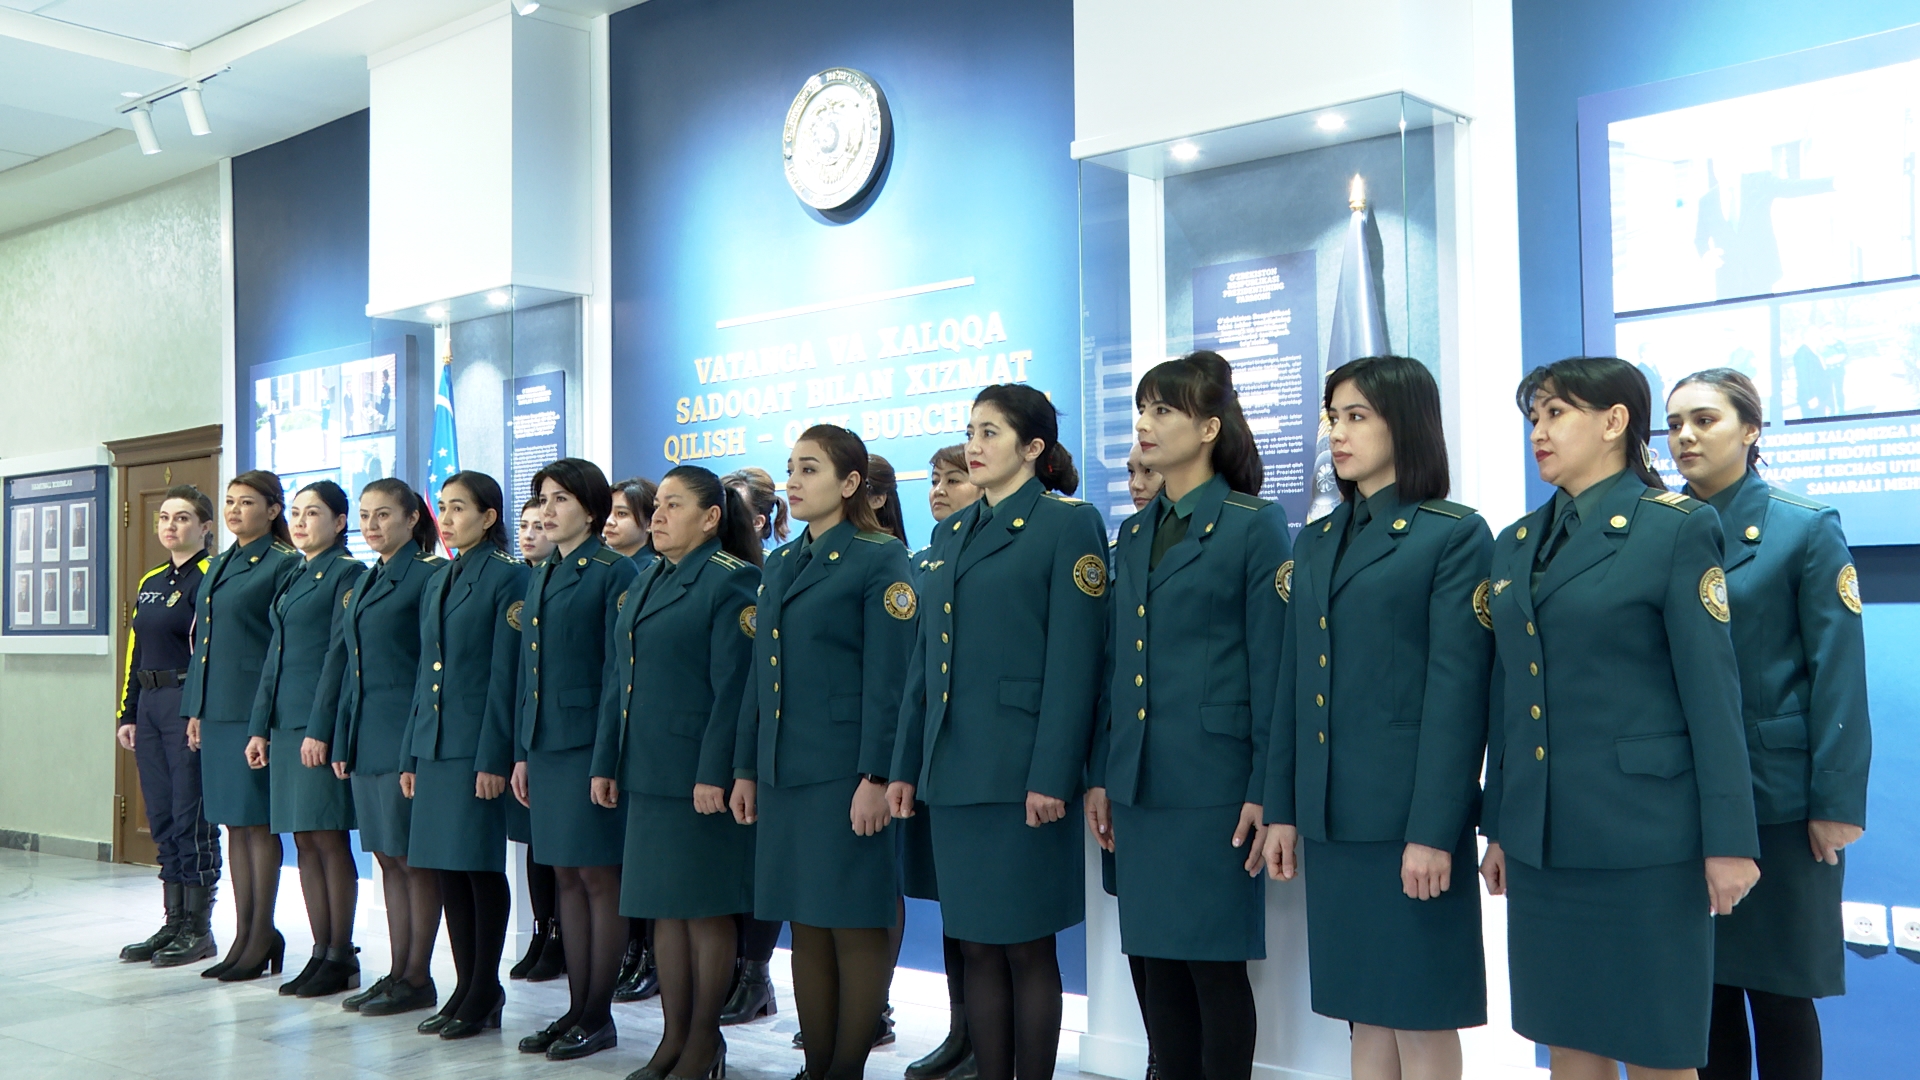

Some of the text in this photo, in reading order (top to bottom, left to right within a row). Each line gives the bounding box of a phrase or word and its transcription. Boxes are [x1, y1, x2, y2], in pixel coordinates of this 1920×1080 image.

[694, 311, 1007, 385] VATANGA VA XALQQA
[676, 350, 1032, 424] SADOQAT BILAN XIZMAT
[1816, 425, 1908, 444] XALQIMIZGA
[664, 427, 746, 466] QILISH
[1776, 448, 1826, 463] UCHUN
[1828, 444, 1877, 460] FIDOYI
[1880, 441, 1920, 456] INSO
[1824, 461, 1887, 477] KECHASI
[1807, 476, 1920, 495] SAMARALI MEH
